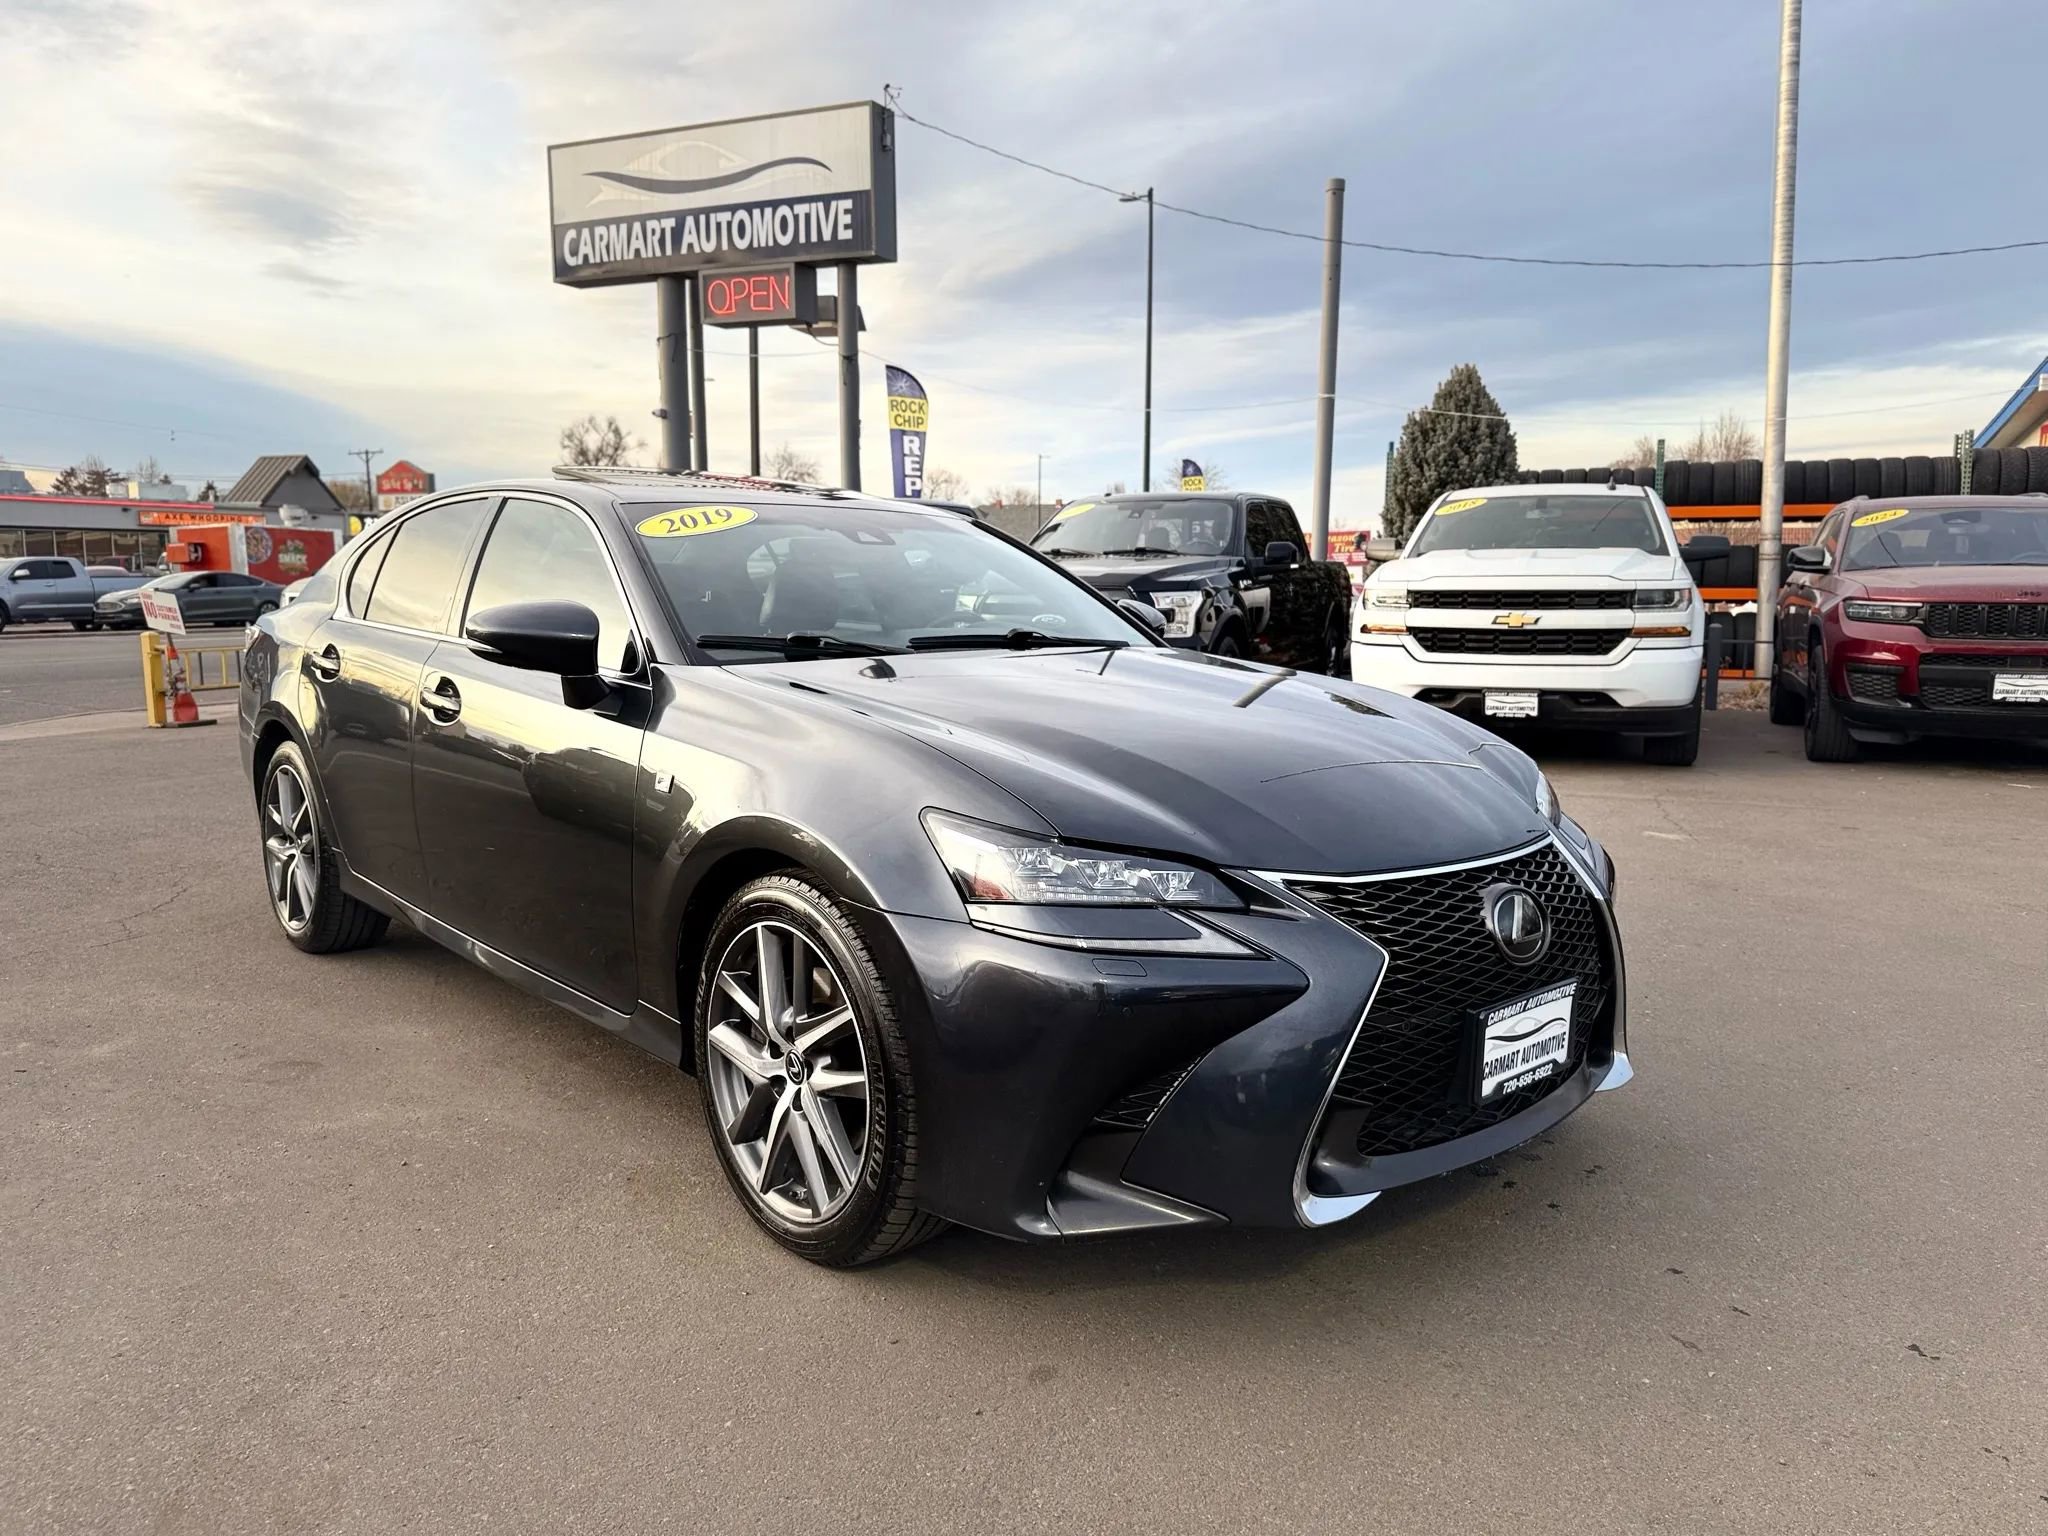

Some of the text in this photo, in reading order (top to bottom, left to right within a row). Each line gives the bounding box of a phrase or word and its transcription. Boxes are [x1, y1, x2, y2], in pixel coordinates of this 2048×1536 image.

[562, 198, 854, 267] CARMART AUTOMOTIVE
[706, 274, 791, 316] OPEN
[889, 399, 927, 415] ROCK
[893, 413, 926, 430] CHIP
[902, 434, 922, 497] REP
[164, 513, 185, 521] AXE
[659, 508, 734, 534] 2019
[143, 600, 158, 619] NO
[1487, 982, 1578, 1026] CARMART AUTOMOTIVE
[1483, 1031, 1567, 1081] CARMART AUTOMOTIVE
[866, 1060, 887, 1192] MICHELIN
